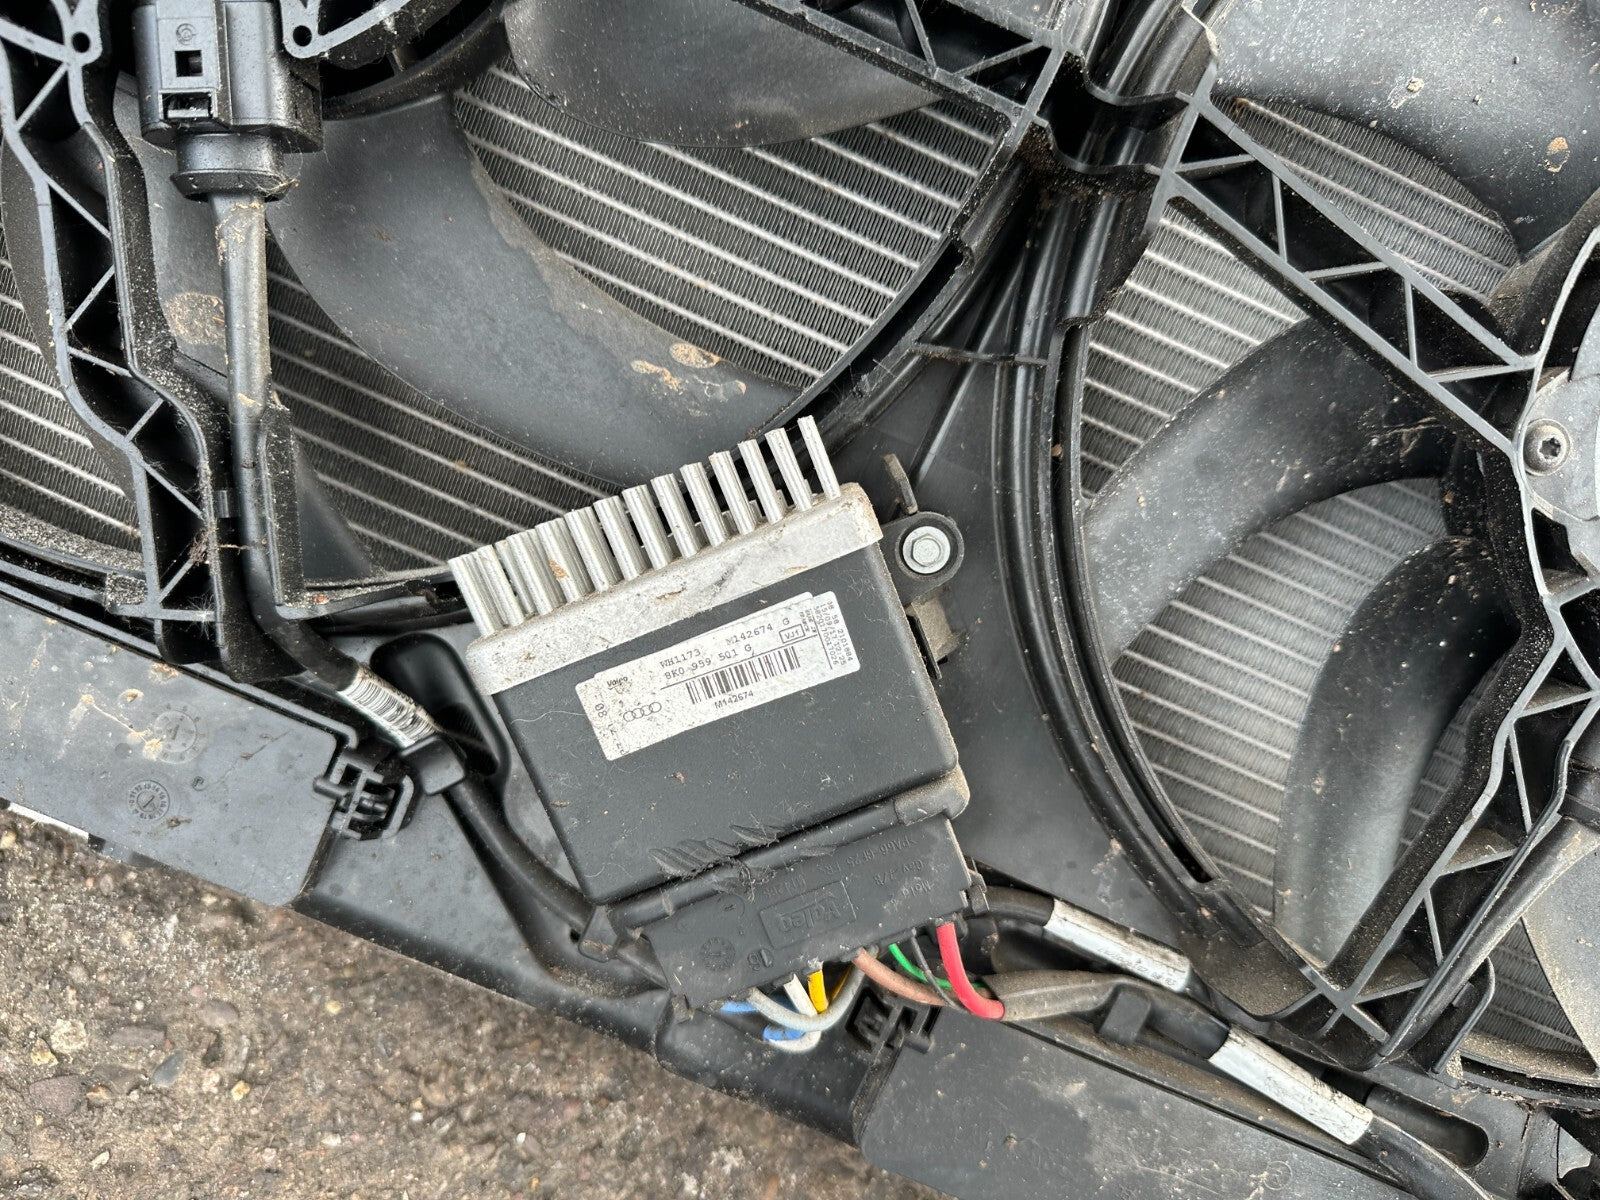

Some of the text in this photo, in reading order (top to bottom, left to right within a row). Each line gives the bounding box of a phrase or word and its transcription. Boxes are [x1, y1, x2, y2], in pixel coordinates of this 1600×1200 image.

[660, 617, 790, 669] WH1173 M142674 G
[784, 629, 800, 641] VJ1
[664, 644, 753, 680] 8K0 959 501 G
[714, 690, 755, 709] M142674
[747, 947, 774, 971] 16
